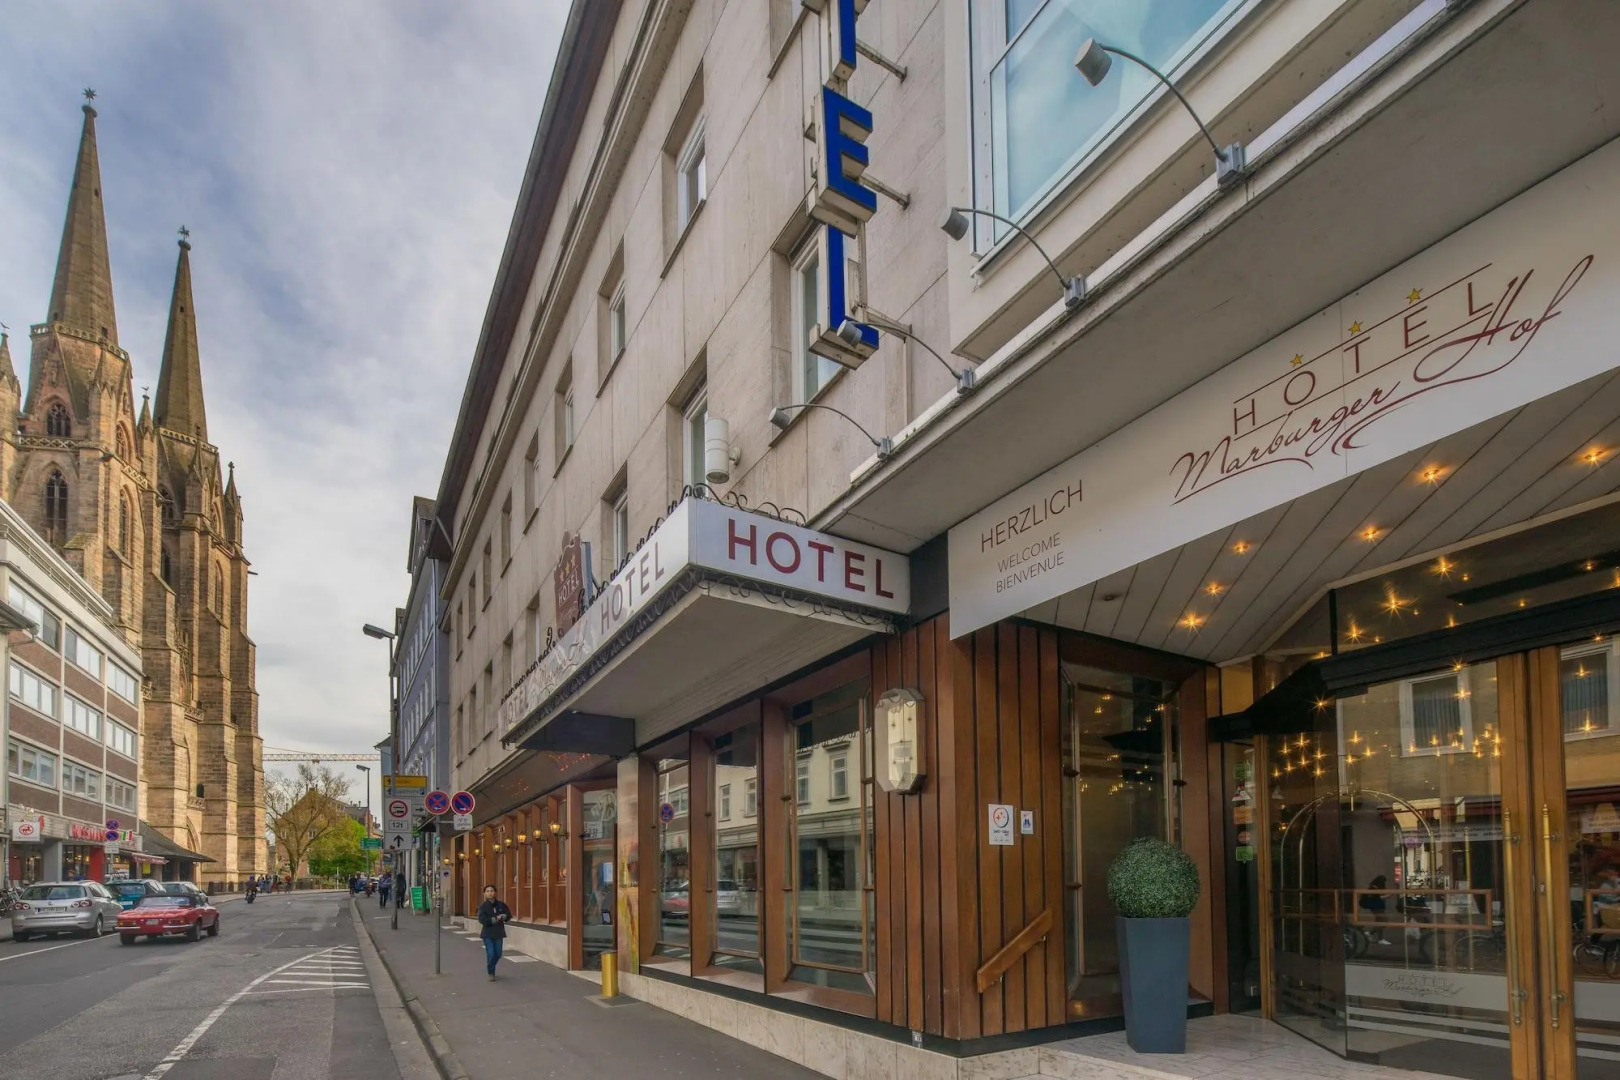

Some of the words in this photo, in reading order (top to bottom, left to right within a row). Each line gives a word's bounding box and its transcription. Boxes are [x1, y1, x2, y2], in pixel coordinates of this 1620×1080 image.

[1232, 281, 1494, 437] HOTEL
[1168, 380, 1401, 499] Marburger
[980, 478, 1083, 553] HERZLICH
[997, 532, 1061, 573] WELCOME
[558, 569, 580, 607] HOTEL
[601, 542, 666, 636] HOTEL
[728, 518, 895, 599] HOTEL
[995, 551, 1065, 594] BIENVENUE
